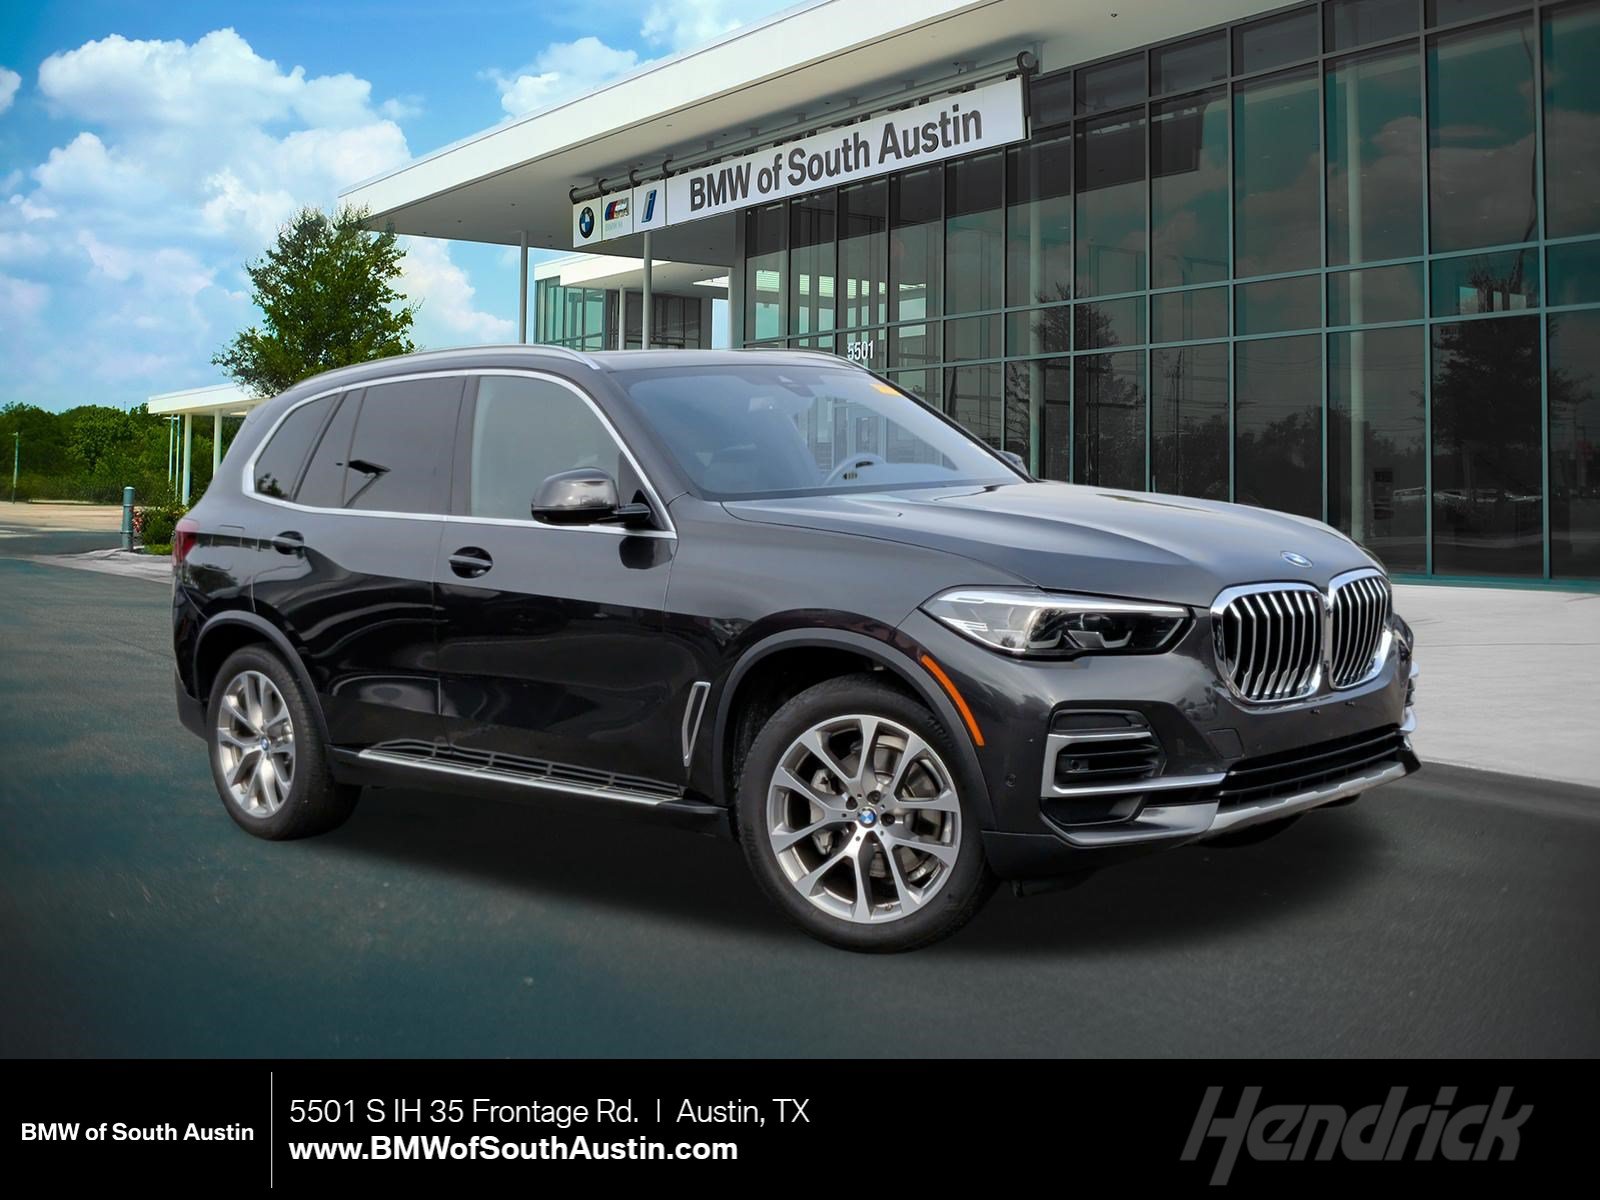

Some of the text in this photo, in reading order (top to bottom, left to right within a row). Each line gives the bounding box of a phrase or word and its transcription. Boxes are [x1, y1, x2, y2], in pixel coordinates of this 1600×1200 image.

[690, 162, 752, 212] BMW
[757, 153, 783, 194] of
[787, 132, 870, 186] South
[878, 104, 982, 165] Austin
[847, 340, 874, 361] 5501
